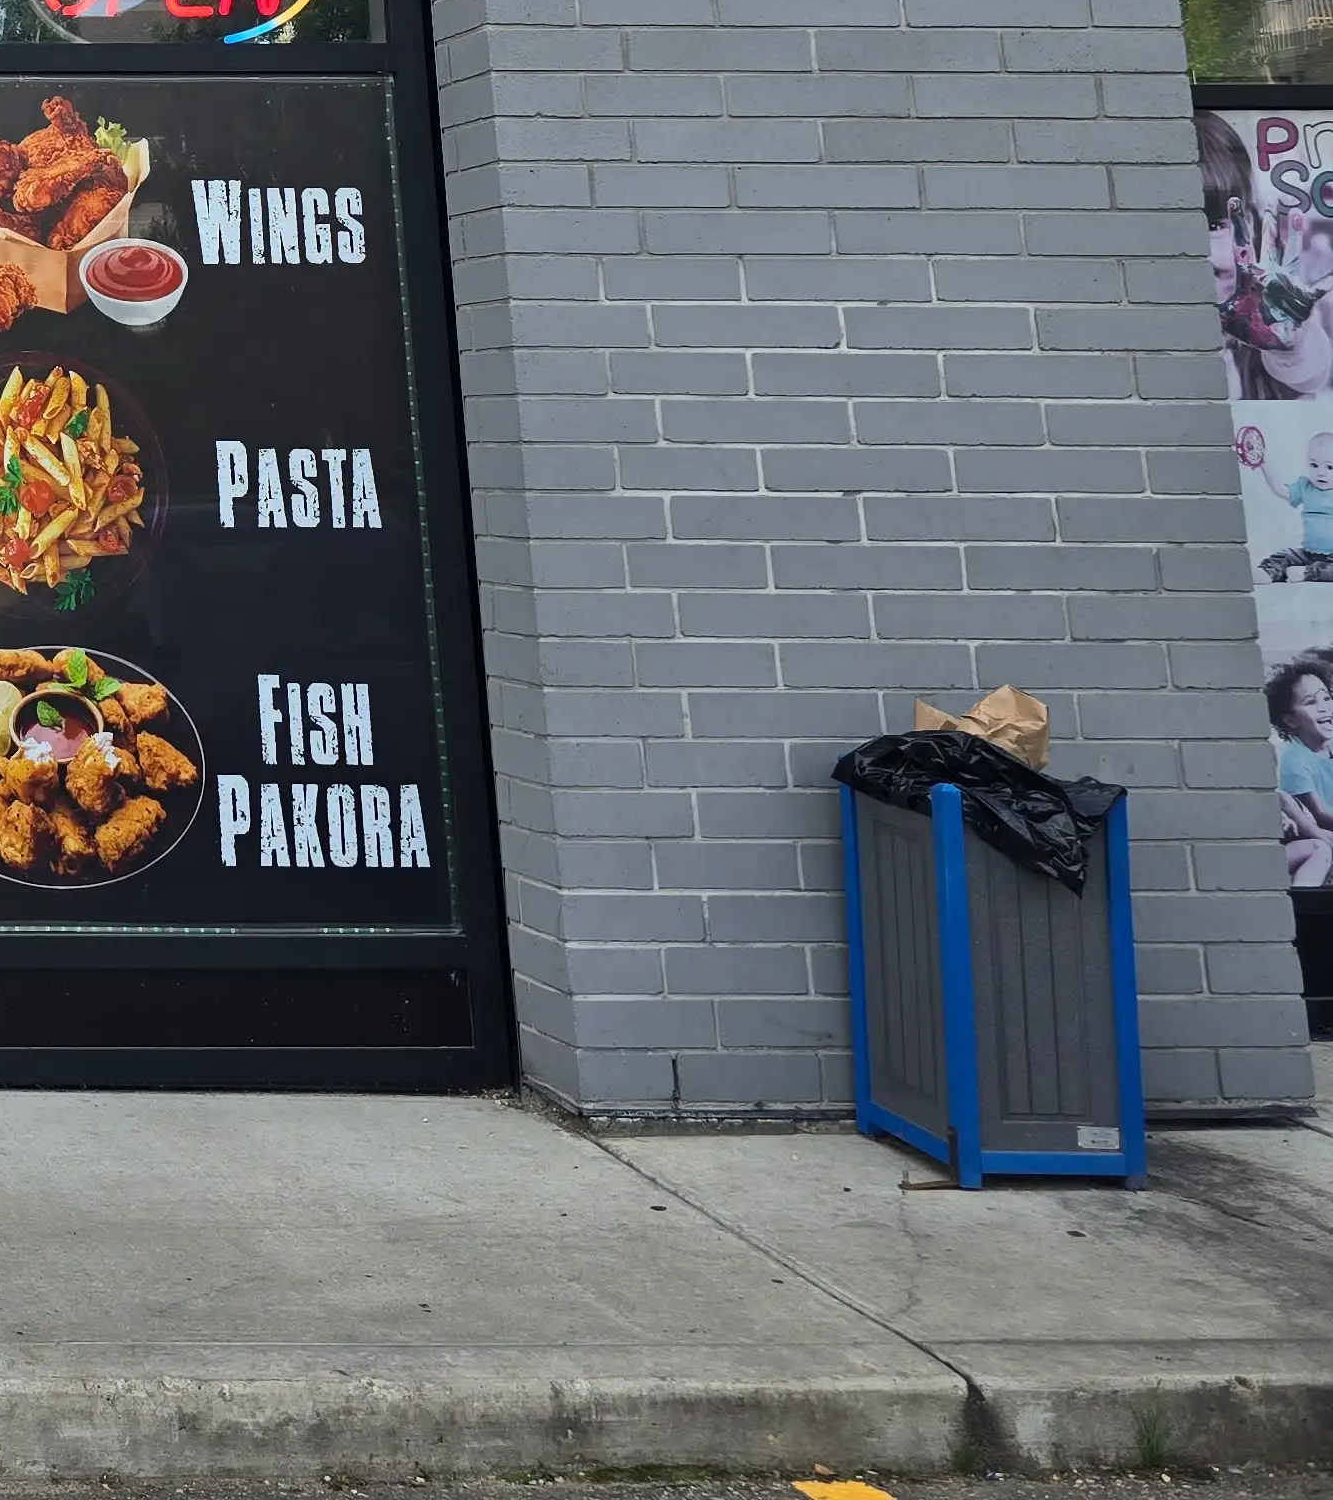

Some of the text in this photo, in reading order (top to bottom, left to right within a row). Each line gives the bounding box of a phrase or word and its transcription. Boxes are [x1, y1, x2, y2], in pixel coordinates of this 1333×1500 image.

[191, 179, 367, 265] WINGS
[215, 440, 383, 529] PASTA
[257, 674, 374, 766] FISH
[217, 775, 430, 868] PAKORA
